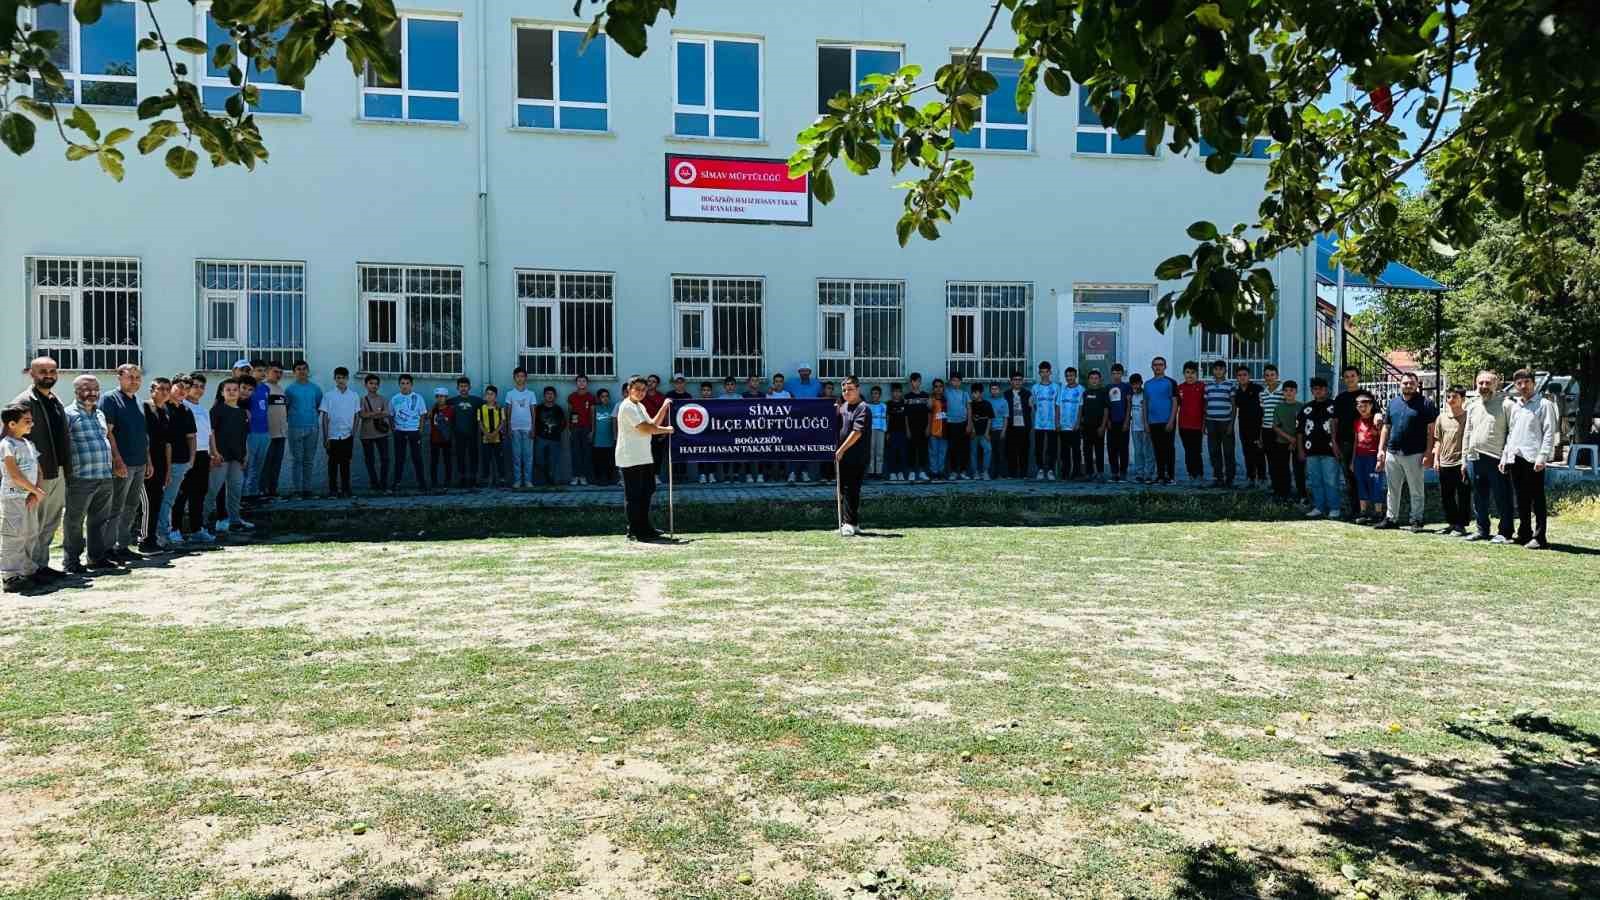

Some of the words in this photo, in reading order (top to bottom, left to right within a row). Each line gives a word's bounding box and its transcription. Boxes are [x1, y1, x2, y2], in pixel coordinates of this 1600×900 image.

[701, 169, 727, 179] SİMAV
[749, 404, 792, 416] SİMAV
[712, 418, 742, 432] İLÇE
[745, 416, 829, 430] MÜFTÜLÜĞÜ
[735, 436, 783, 444] BOĞAZKÖY
